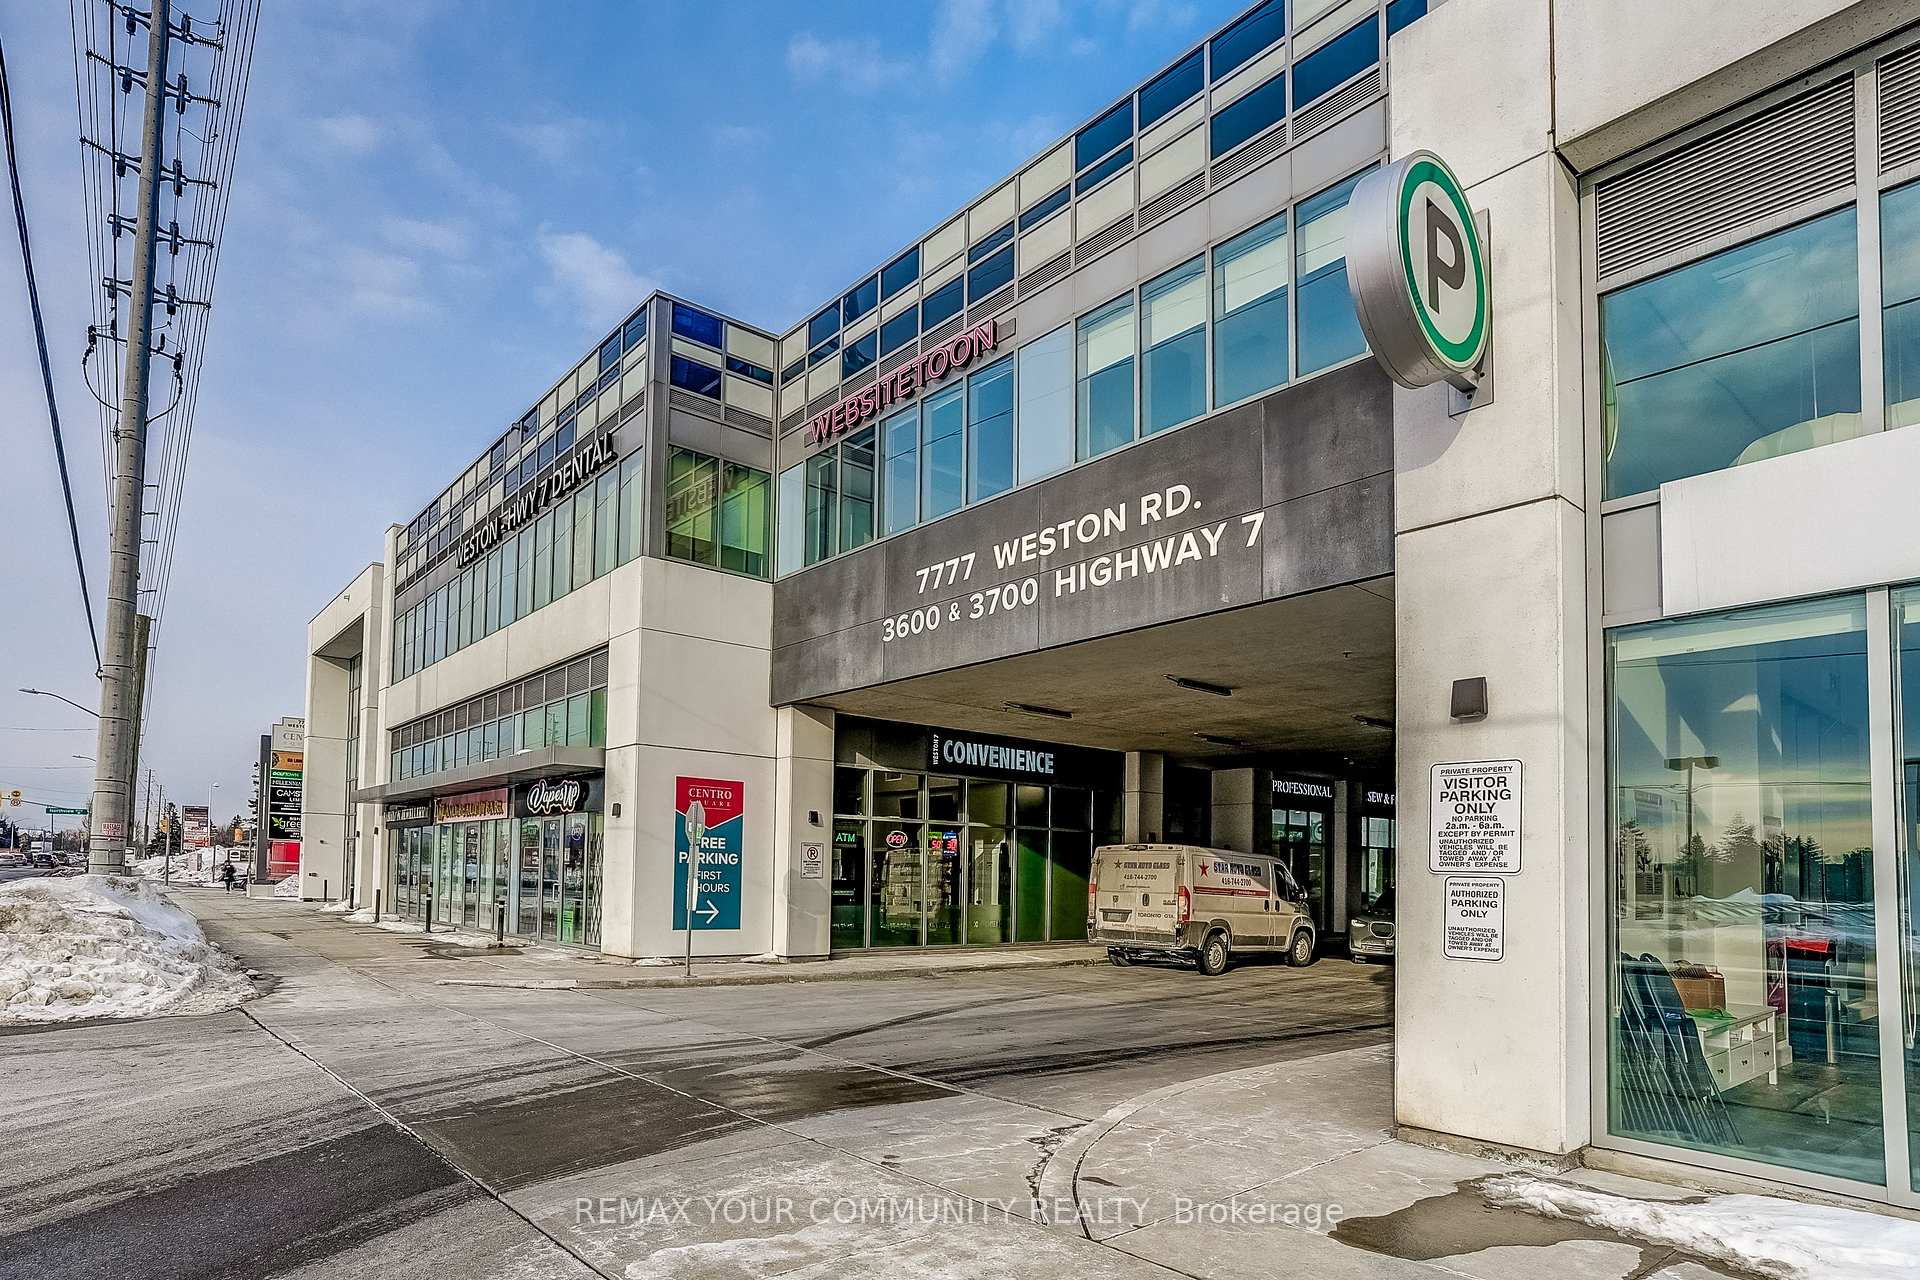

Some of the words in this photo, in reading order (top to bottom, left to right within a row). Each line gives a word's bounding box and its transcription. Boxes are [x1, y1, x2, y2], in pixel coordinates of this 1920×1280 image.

[809, 318, 997, 443] WEBSITETOON
[455, 516, 500, 568] WESTON
[507, 487, 538, 531] HWY
[539, 479, 551, 508] 7
[549, 432, 617, 499] DENTAL
[915, 551, 976, 595] 7777
[993, 503, 1127, 570] WESTON
[1140, 484, 1202, 526] RD.
[881, 604, 941, 643] 3600
[947, 601, 962, 622] &
[969, 577, 1039, 619] 3700
[1054, 522, 1227, 598] HIGHWAY
[1241, 511, 1266, 548] 7
[283, 732, 304, 741] CEN
[943, 740, 1054, 774] CONVENIENCE
[1272, 779, 1332, 798] PROFESSIONAL
[1443, 776, 1507, 789] VISITOR
[688, 788, 732, 799] CENTRO
[1367, 791, 1383, 803] SEW
[1383, 793, 1390, 804] &
[1390, 794, 1395, 805] F
[1440, 789, 1511, 802] PARKING
[1454, 802, 1496, 814] ONLY
[699, 837, 726, 849] REE
[835, 832, 856, 843] ATM
[888, 833, 906, 844] OPEN
[1214, 861, 1229, 874] STAR
[1450, 890, 1498, 898] AUTHORIZED
[1451, 900, 1498, 908] PARKING
[1460, 910, 1488, 918] ONLY
